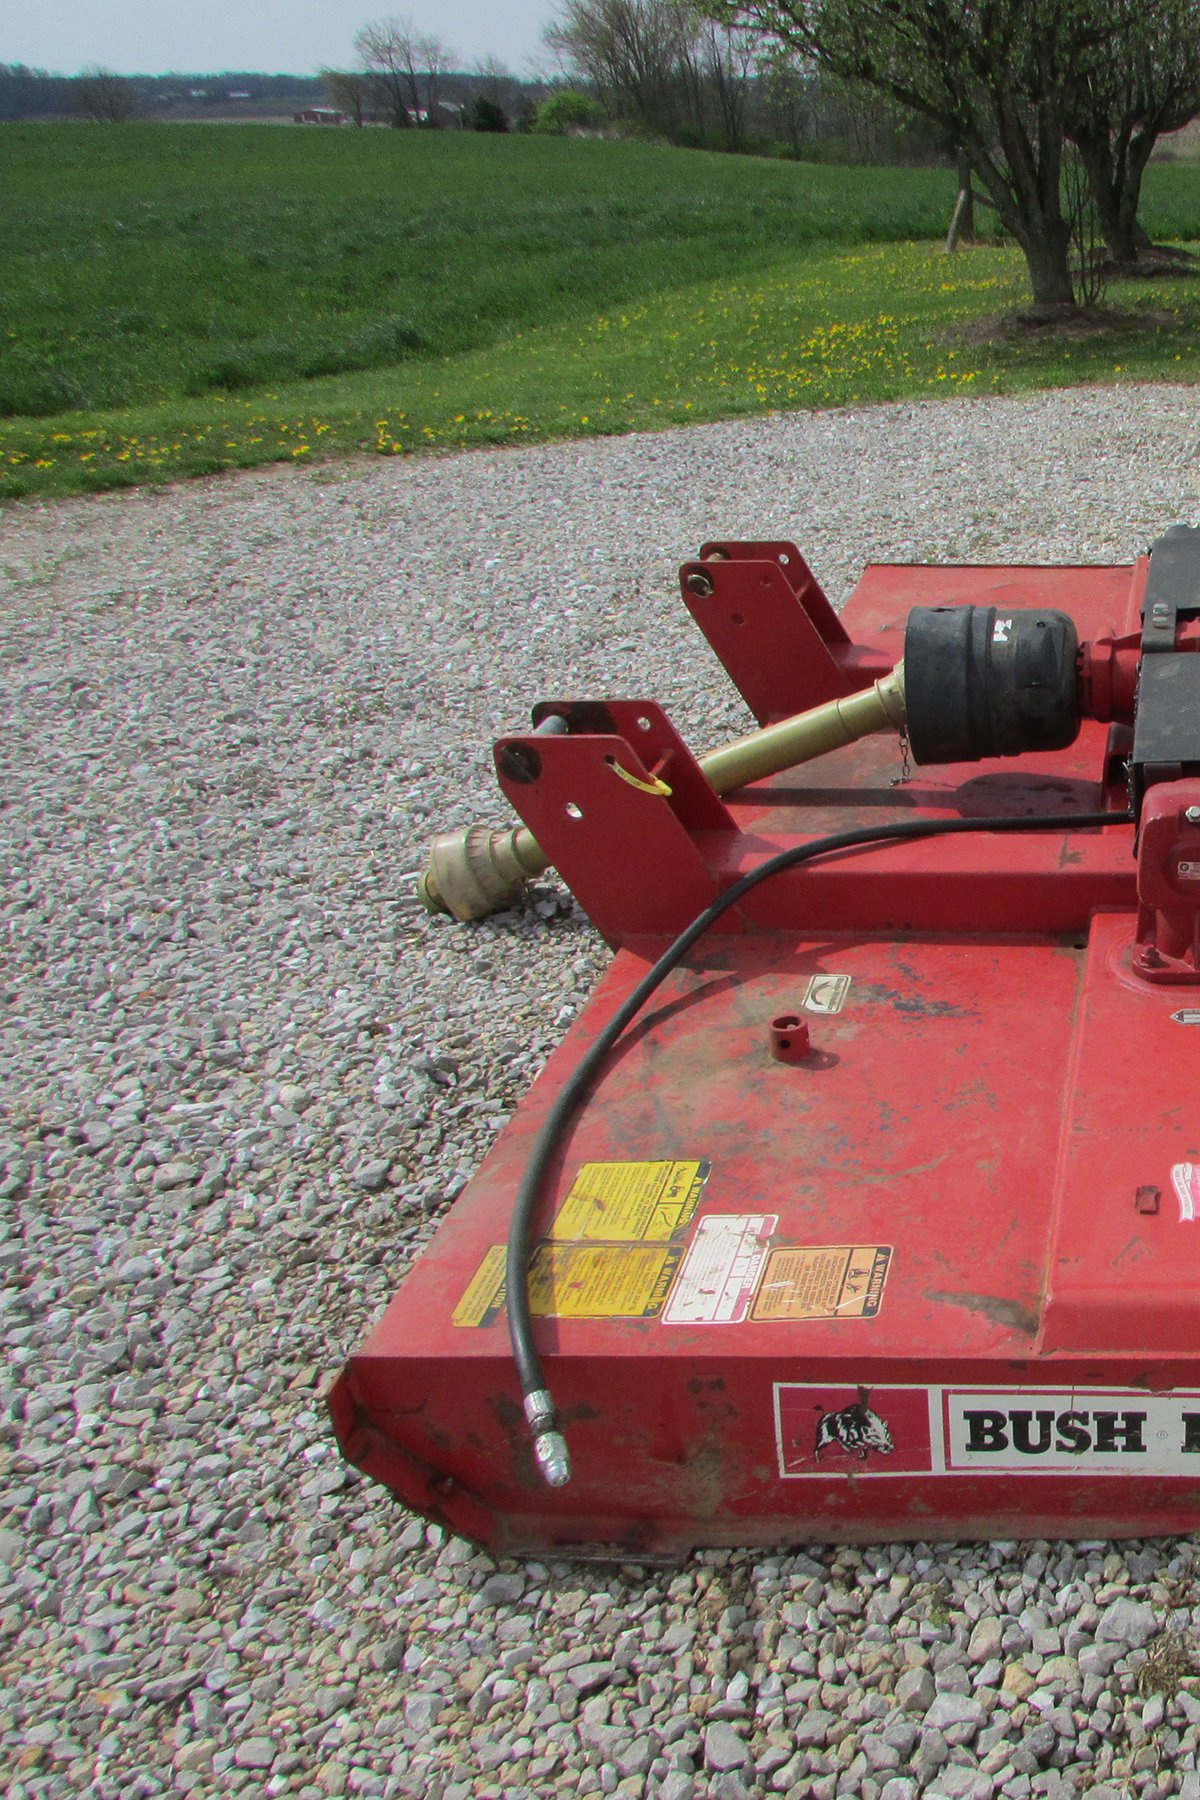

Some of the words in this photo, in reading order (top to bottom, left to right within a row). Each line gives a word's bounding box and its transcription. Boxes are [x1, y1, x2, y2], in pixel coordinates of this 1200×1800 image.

[648, 1267, 672, 1309] WARNIG
[741, 1254, 761, 1289] DANGER
[867, 1263, 886, 1307] WARNING
[963, 1410, 1147, 1455] BUSH
